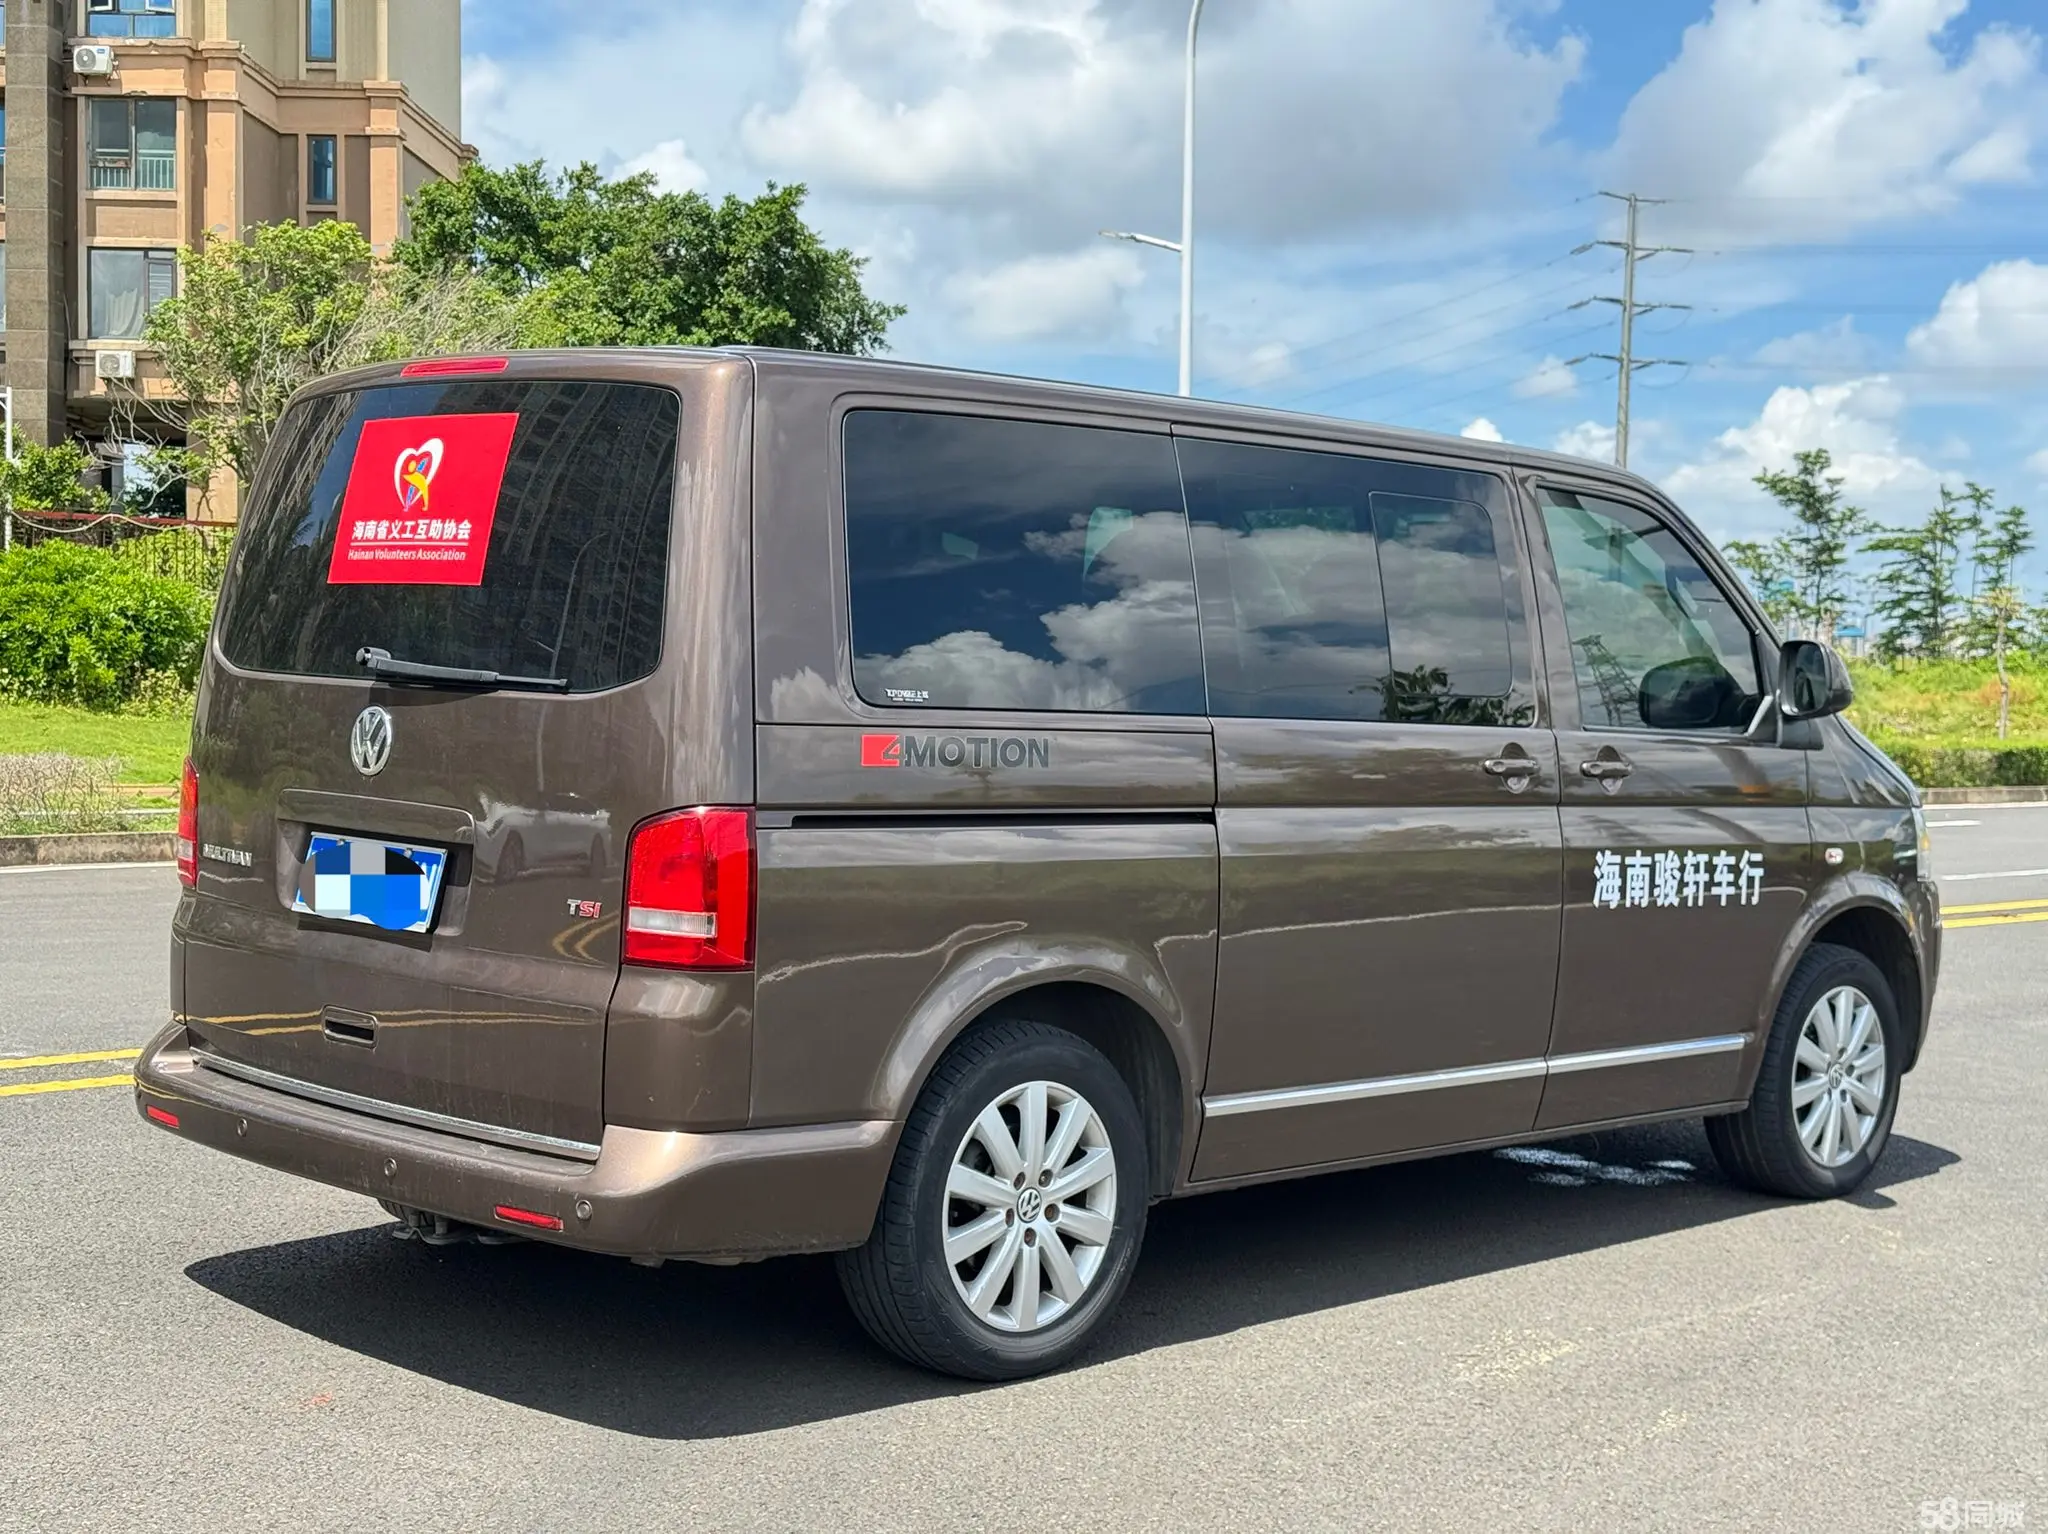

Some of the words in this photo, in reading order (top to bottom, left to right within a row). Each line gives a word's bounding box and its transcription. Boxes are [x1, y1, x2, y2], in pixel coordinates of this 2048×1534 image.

[351, 519, 472, 540] 海南省义工互助协会
[347, 549, 374, 560] Hainan
[374, 548, 416, 560] Volunteers
[416, 548, 466, 560] Association
[878, 735, 1049, 768] 4MOTION
[1593, 849, 1765, 910] 海南骏轩车行
[567, 898, 602, 919] TSI
